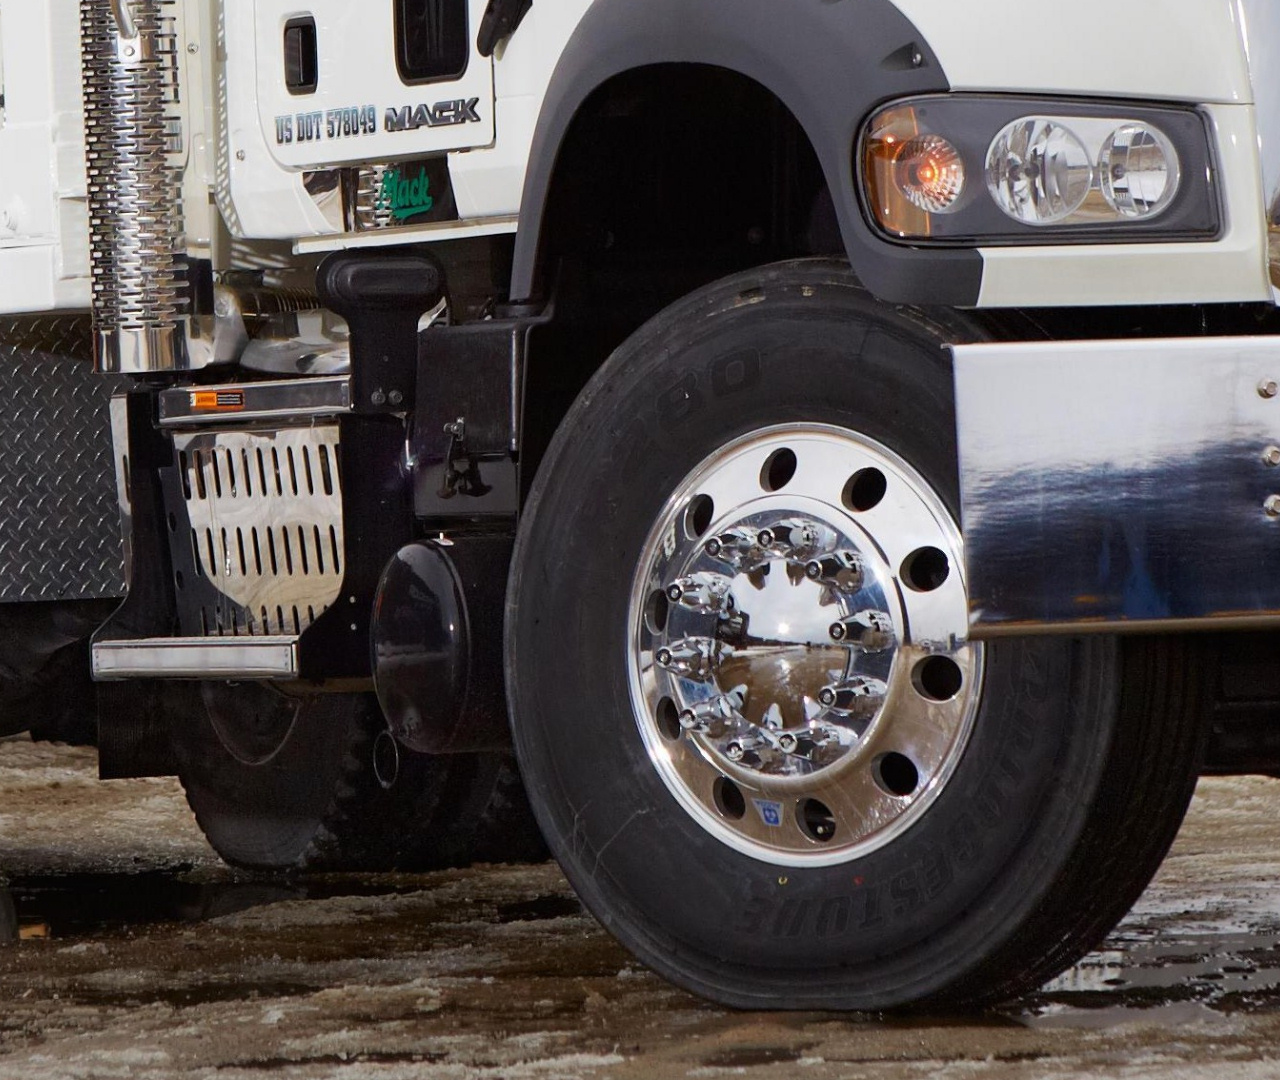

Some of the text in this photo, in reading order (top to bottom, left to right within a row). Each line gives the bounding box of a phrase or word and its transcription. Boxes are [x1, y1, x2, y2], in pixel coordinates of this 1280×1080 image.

[275, 104, 376, 144] US DOT 578049
[384, 97, 481, 132] MACK
[378, 165, 433, 219] Mack
